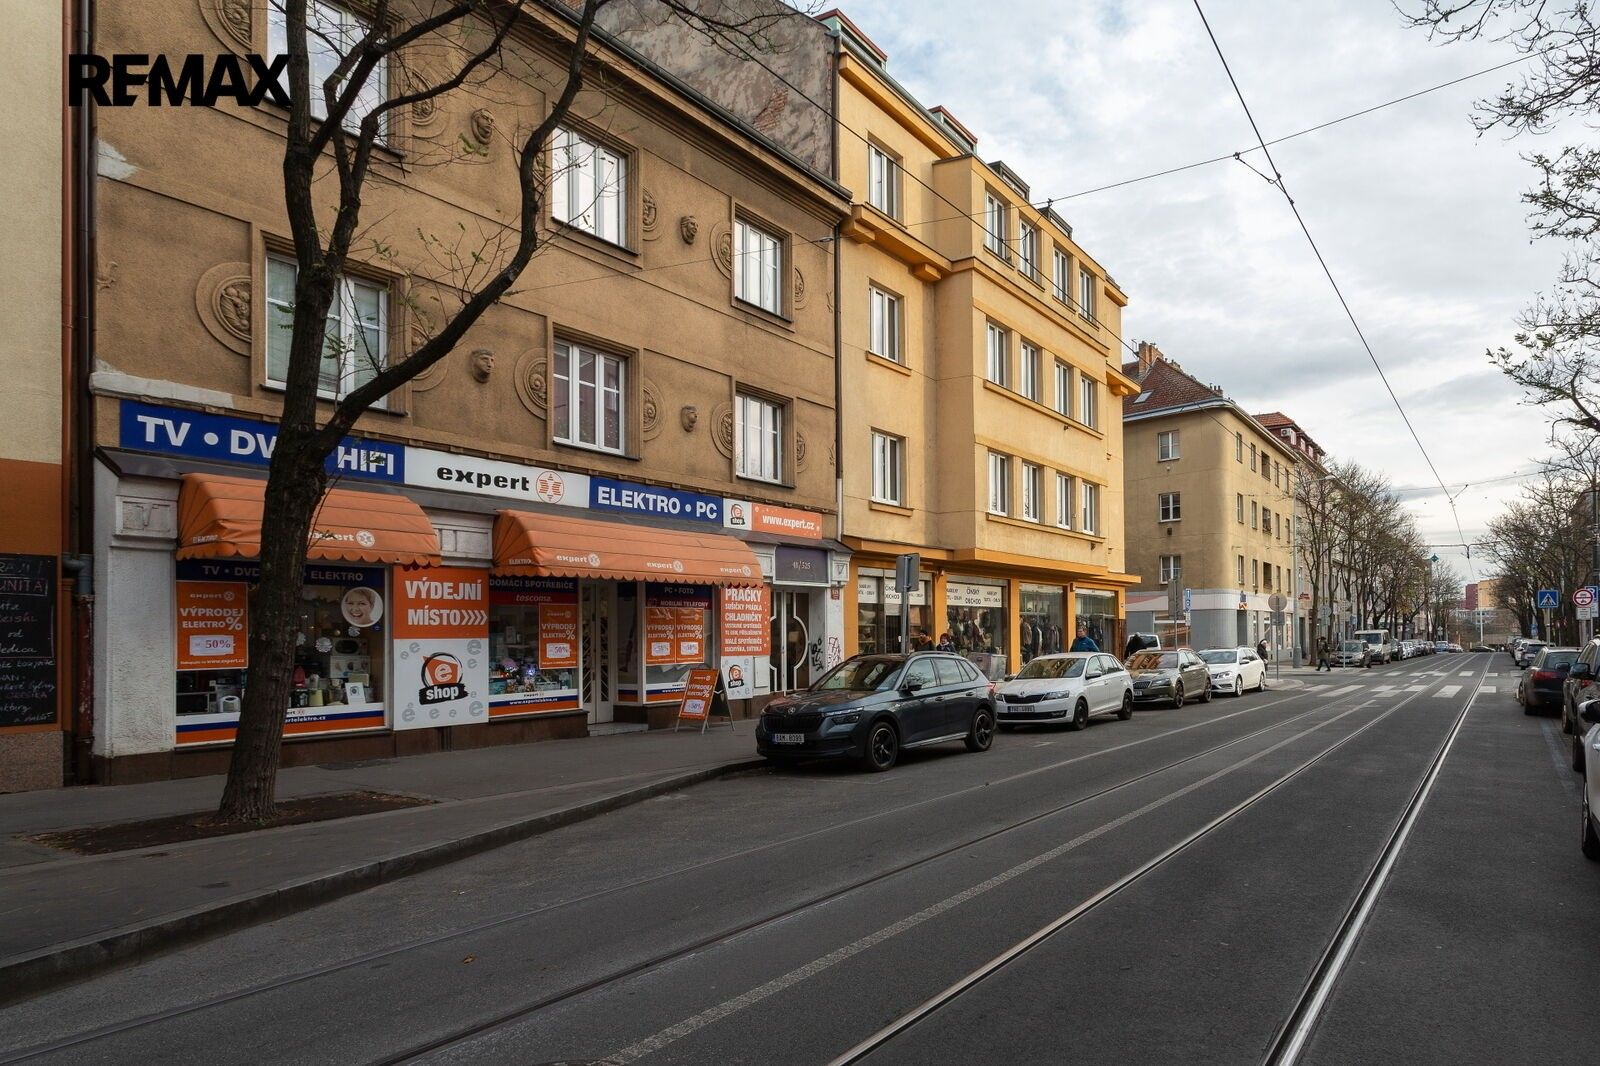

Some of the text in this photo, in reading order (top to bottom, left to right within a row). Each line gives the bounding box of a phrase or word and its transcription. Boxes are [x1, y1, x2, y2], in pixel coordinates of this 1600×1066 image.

[137, 415, 394, 475] TV DV HIFI
[436, 466, 530, 491] expert
[597, 486, 718, 520] ELEKTRO PC
[762, 515, 815, 530] www.expert.cz
[556, 554, 588, 564] expert
[646, 562, 673, 571] expert
[201, 565, 220, 576] TV
[311, 570, 364, 581] ELEKTRO
[720, 567, 743, 575] expert
[405, 577, 482, 601] VÝDEJNÍ
[725, 586, 762, 602] PRAČKY
[180, 605, 244, 617] VÝPRODEJ
[407, 605, 461, 625] MÍSTO
[182, 620, 225, 628] ELEKTRO
[434, 663, 453, 682] e
[426, 686, 460, 701] shop
